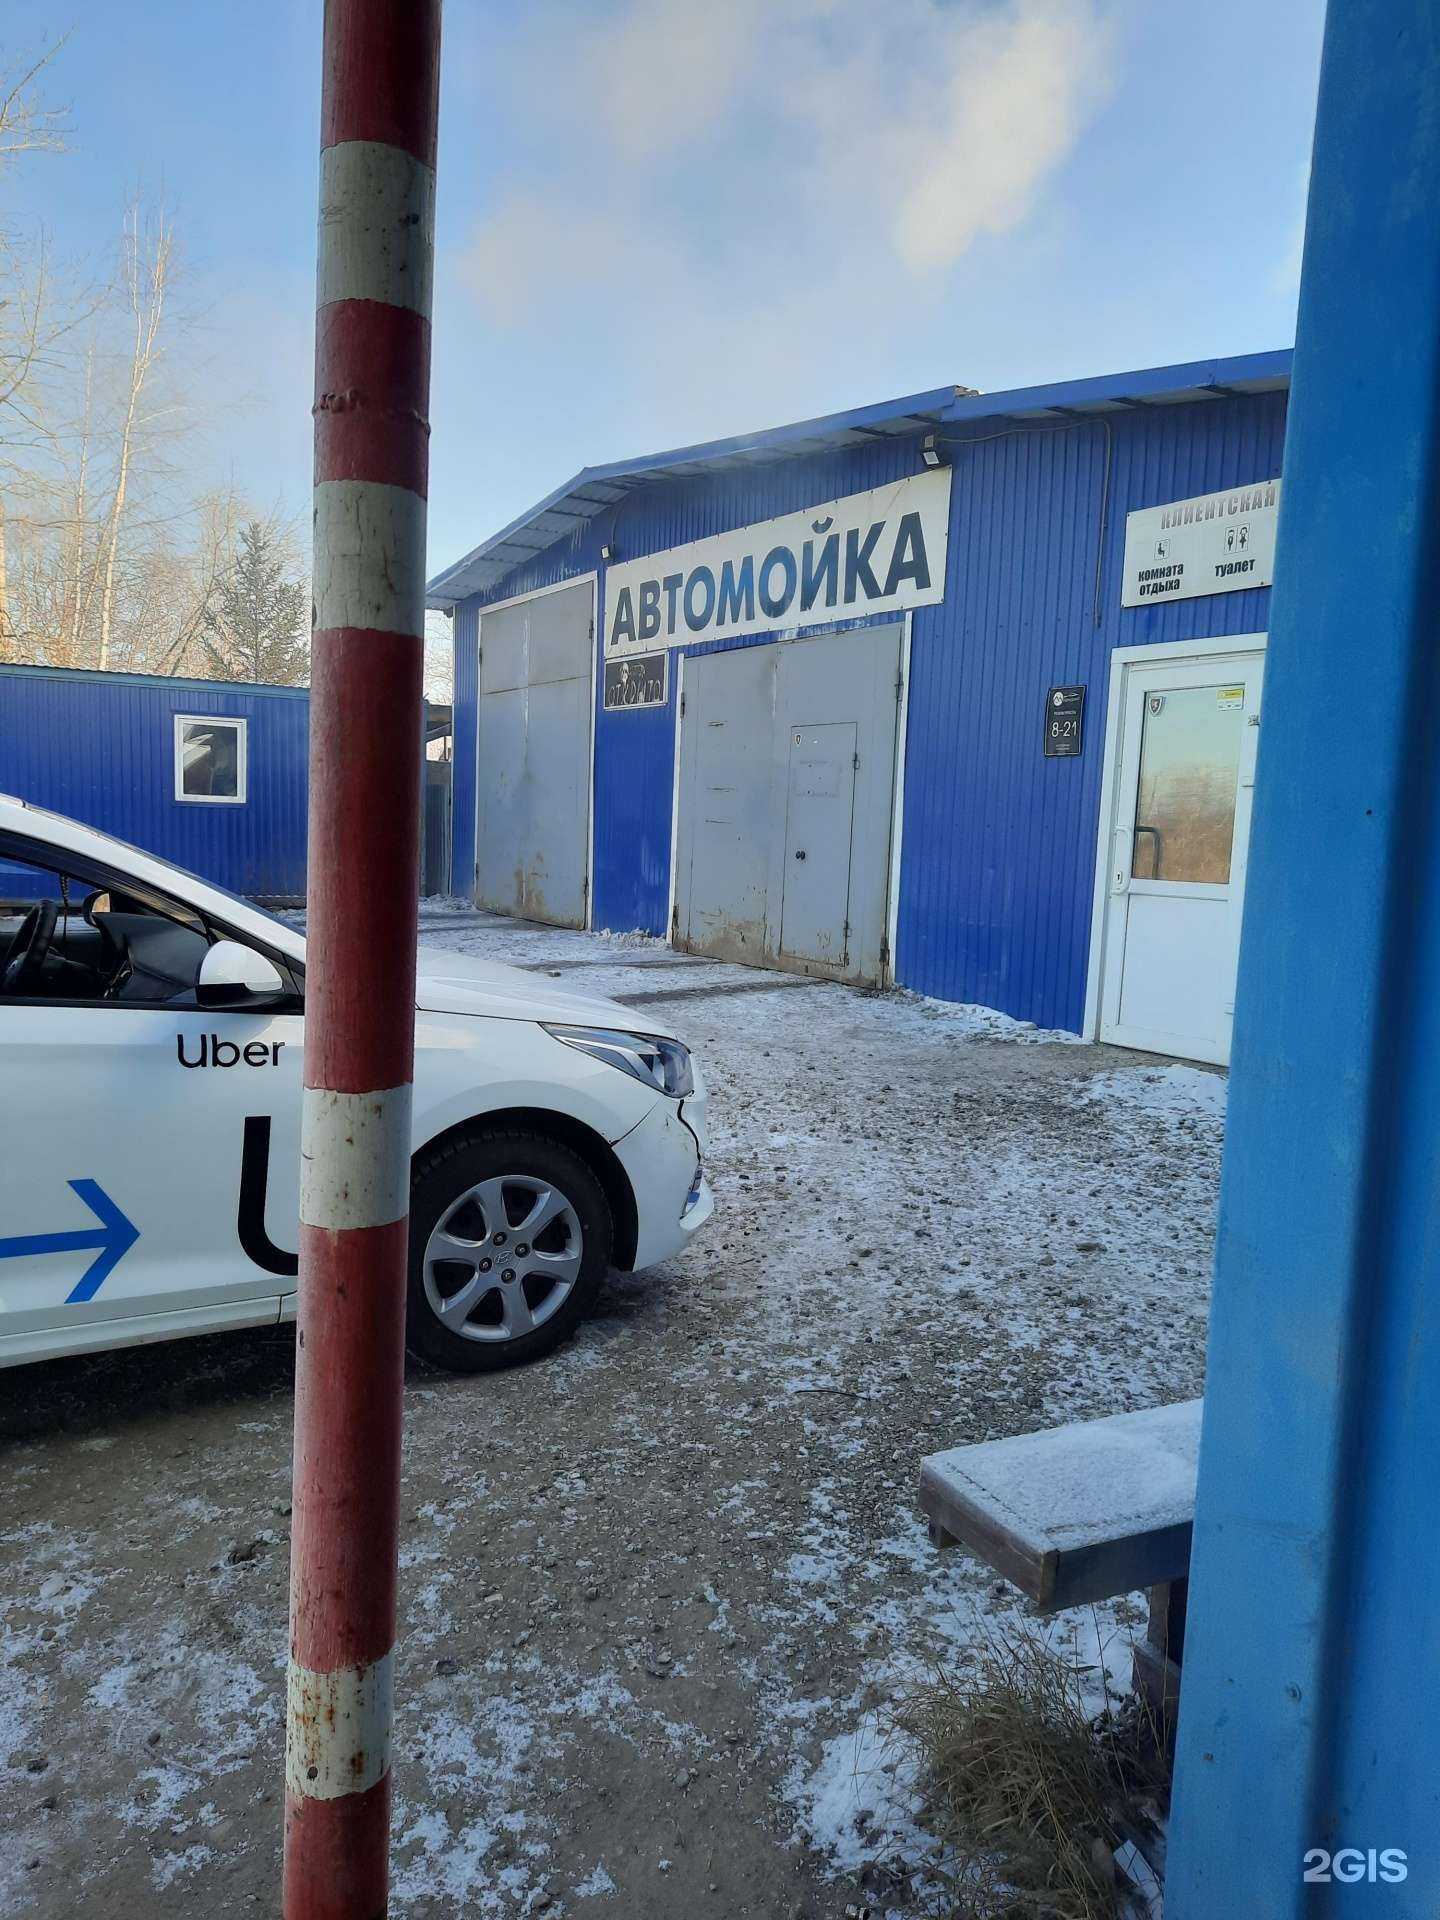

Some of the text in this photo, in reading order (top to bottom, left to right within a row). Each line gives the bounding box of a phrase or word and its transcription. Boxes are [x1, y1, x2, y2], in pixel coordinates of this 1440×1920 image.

[1160, 487, 1275, 529] КЛИЕНТСКАЯ
[610, 511, 931, 645] АВТОМОЙКА
[1138, 563, 1184, 582] комната
[1215, 558, 1255, 578] туалет
[1139, 579, 1181, 596] отдыха
[1051, 721, 1077, 738] 8-21
[177, 1034, 286, 1068] Uber
